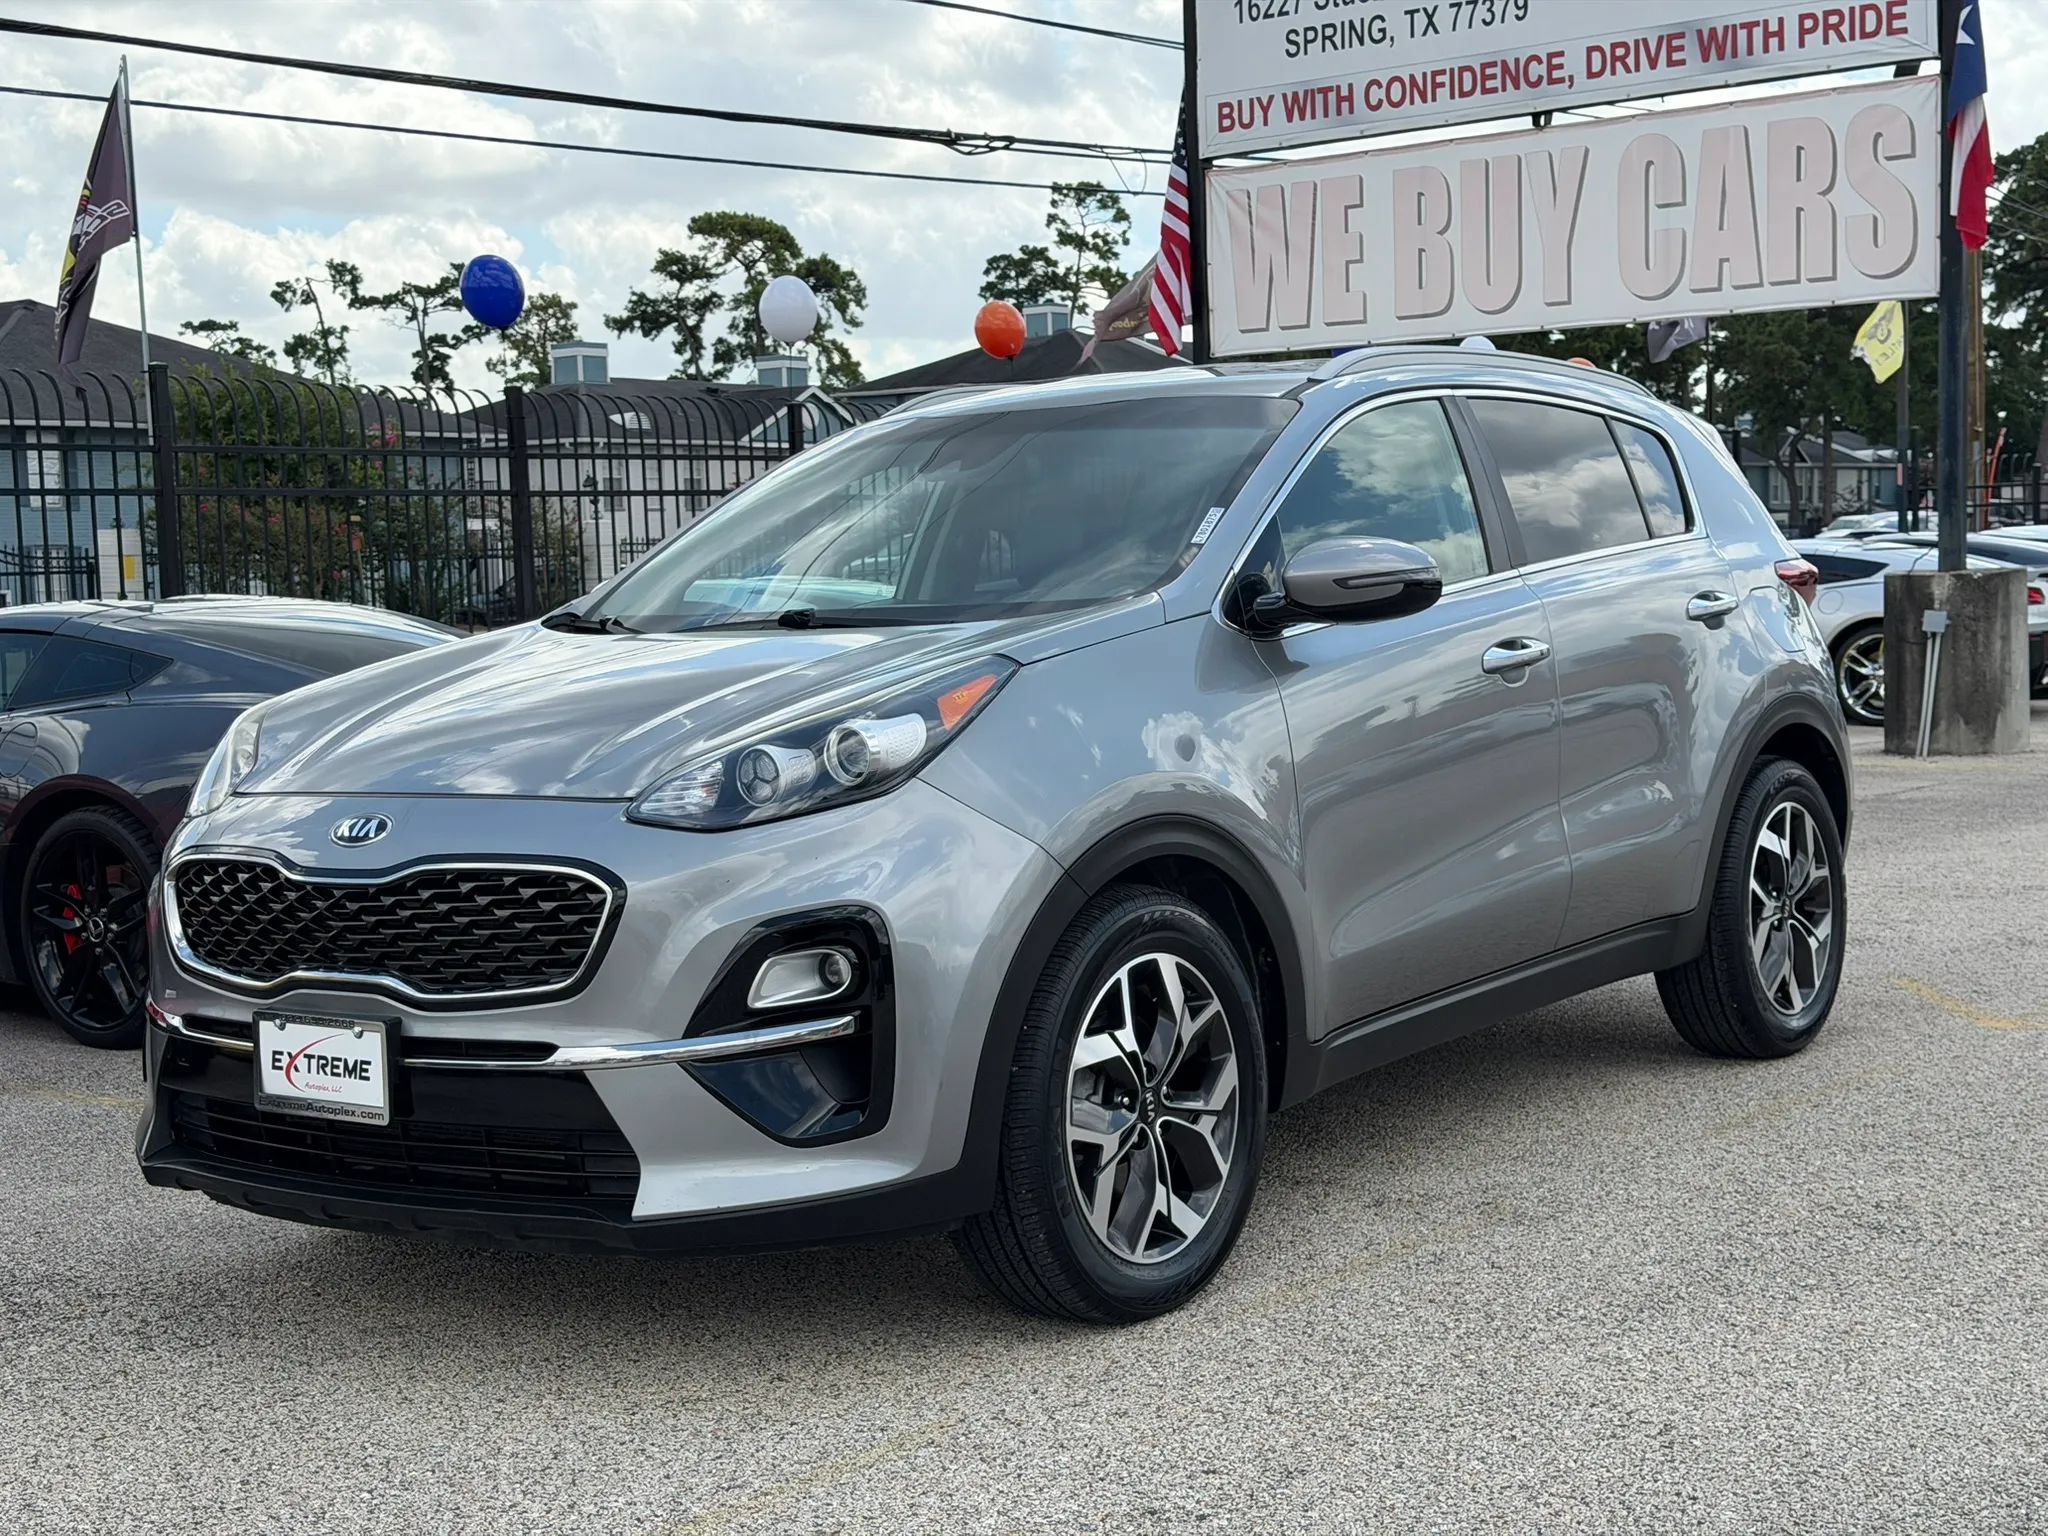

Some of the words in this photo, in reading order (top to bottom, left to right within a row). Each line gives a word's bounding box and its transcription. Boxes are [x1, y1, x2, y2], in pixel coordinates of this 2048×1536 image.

[1285, 14, 1394, 58] SPRING,
[1404, 5, 1440, 39] TX
[1448, 0, 1529, 32] 77379
[1217, 94, 1275, 133] BUY
[1281, 82, 1355, 124] WITH
[1364, 50, 1575, 113] CONFIDENCE,
[1585, 32, 1687, 80] DRIVE
[1696, 16, 1785, 63] WITH
[1798, 0, 1909, 49] PRIDE
[1226, 174, 1367, 333] WE
[1393, 145, 1589, 321] BUY
[1617, 103, 1919, 301] CARS
[337, 818, 380, 838] KIA
[271, 1050, 372, 1082] EXTREME
[1146, 1091, 1155, 1122] KIA
